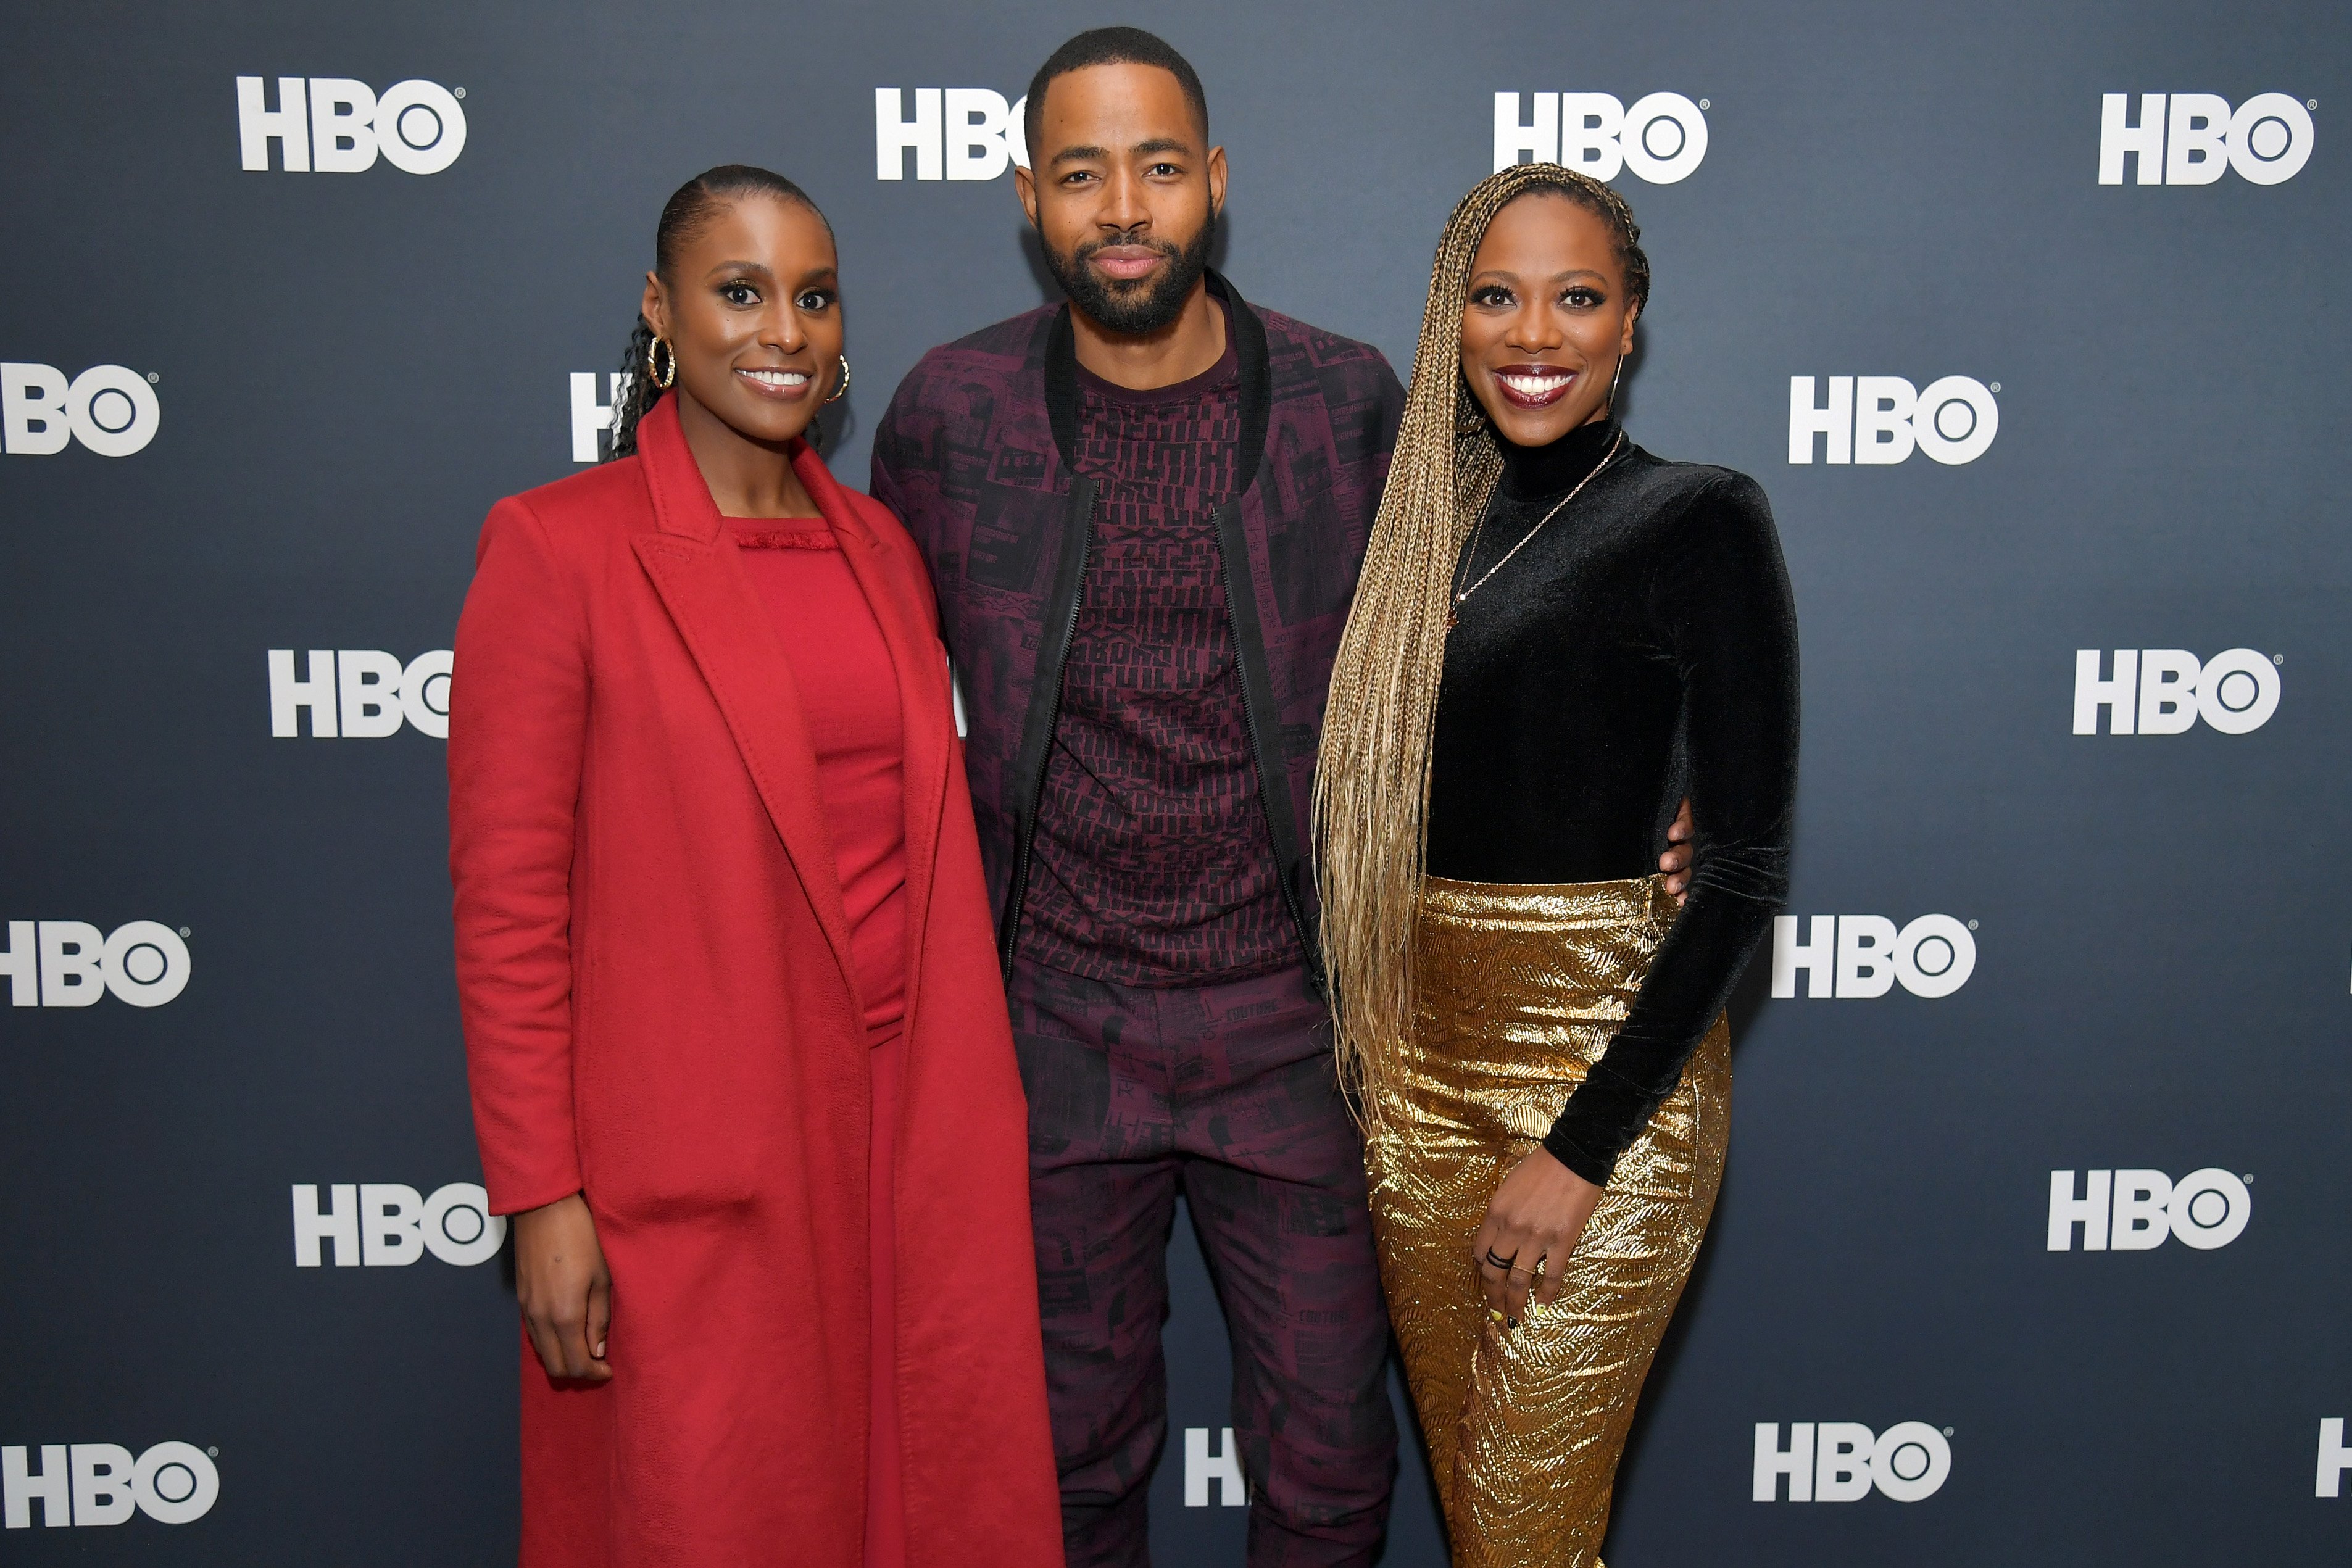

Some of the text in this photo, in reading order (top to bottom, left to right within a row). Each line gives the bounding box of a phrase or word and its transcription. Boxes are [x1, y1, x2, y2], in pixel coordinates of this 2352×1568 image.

[237, 76, 467, 175] HBO
[1494, 91, 1709, 185] HBO
[2098, 93, 2315, 186] HBO
[0, 363, 160, 457] BO
[1789, 376, 1999, 465] HBO
[268, 650, 454, 739] HBO
[2073, 649, 2282, 735] HBO
[1771, 913, 1977, 998] HBO
[292, 1182, 507, 1267] HBO
[2047, 1168, 2251, 1251] HBO
[1, 1441, 220, 1529] HBO
[1753, 1421, 1952, 1502] HBO
